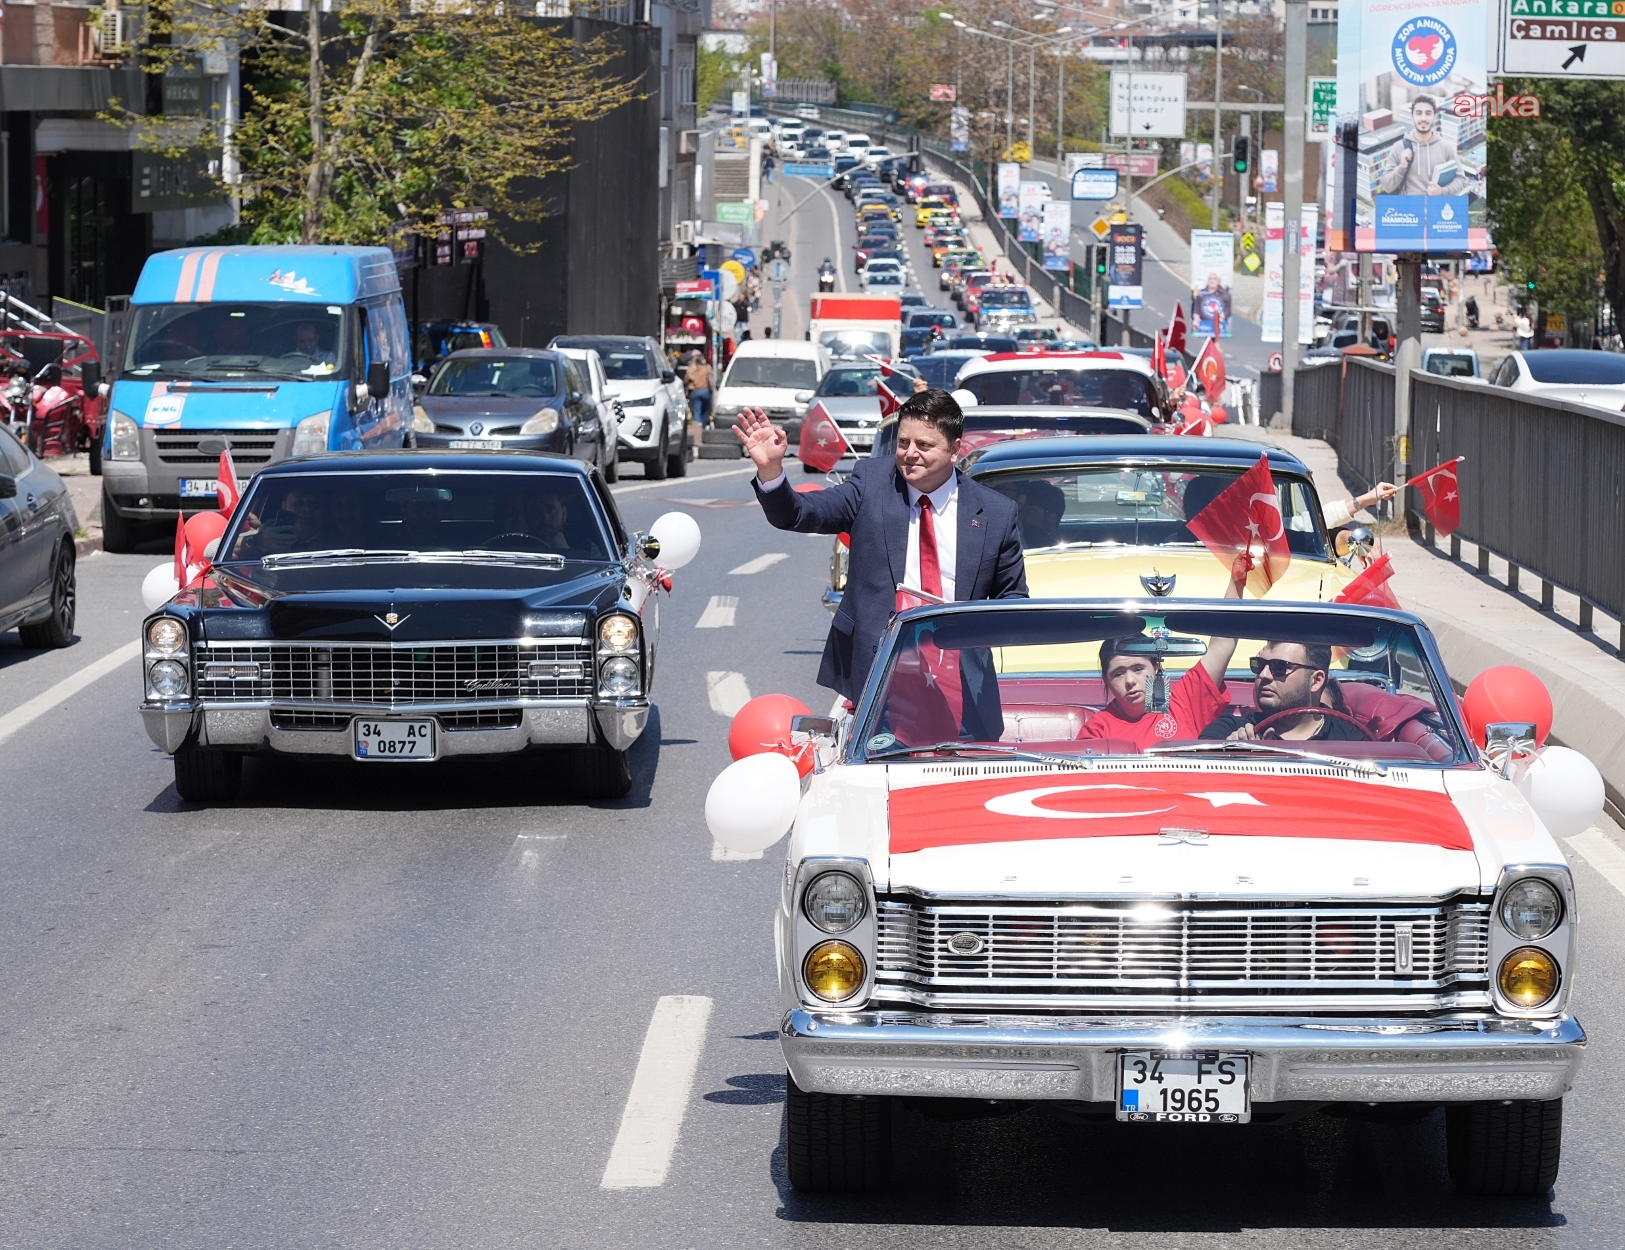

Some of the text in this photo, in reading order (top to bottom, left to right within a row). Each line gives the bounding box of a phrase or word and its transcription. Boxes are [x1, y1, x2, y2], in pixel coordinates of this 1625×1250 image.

[1513, 0, 1608, 14] Ankara
[1398, 19, 1451, 42] ZOR ANINDA
[1512, 19, 1617, 39] Çamlıca
[1425, 47, 1455, 82] YANINDA
[187, 482, 199, 493] 34
[362, 724, 427, 737] 34 AC
[377, 740, 417, 753] 0877
[1132, 1059, 1236, 1085] 34 FS
[1159, 1087, 1220, 1113] 1965
[1125, 1104, 1136, 1112] TR
[1156, 1113, 1211, 1122] FORD
